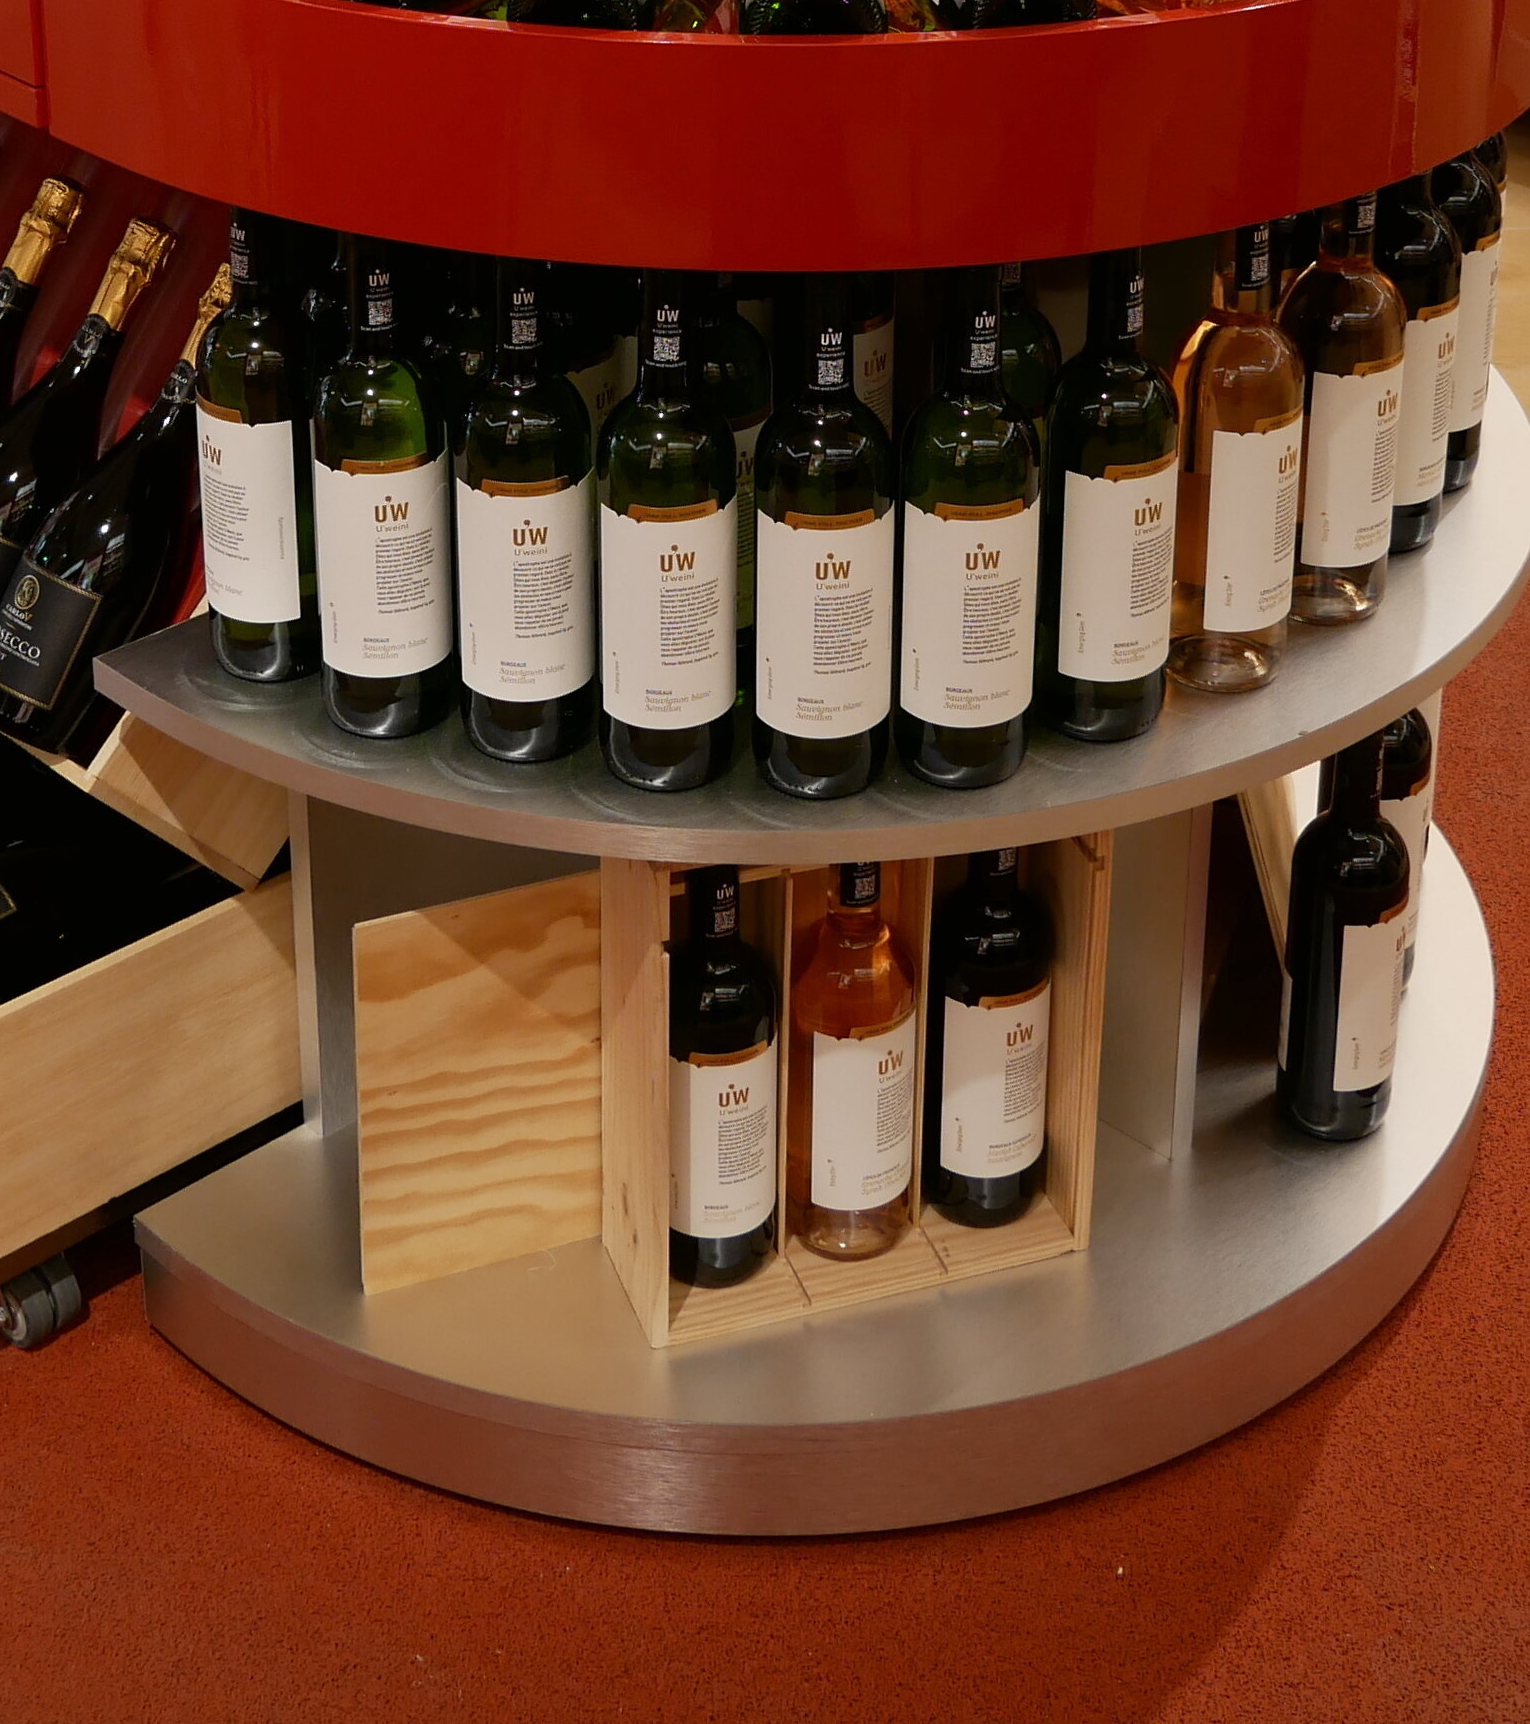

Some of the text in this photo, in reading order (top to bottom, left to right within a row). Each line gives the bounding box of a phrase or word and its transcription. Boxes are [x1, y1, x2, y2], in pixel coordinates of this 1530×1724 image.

[362, 642, 403, 656] Sauvignon
[499, 667, 539, 680] Sauvignon
[645, 694, 689, 707] Sauvignon
